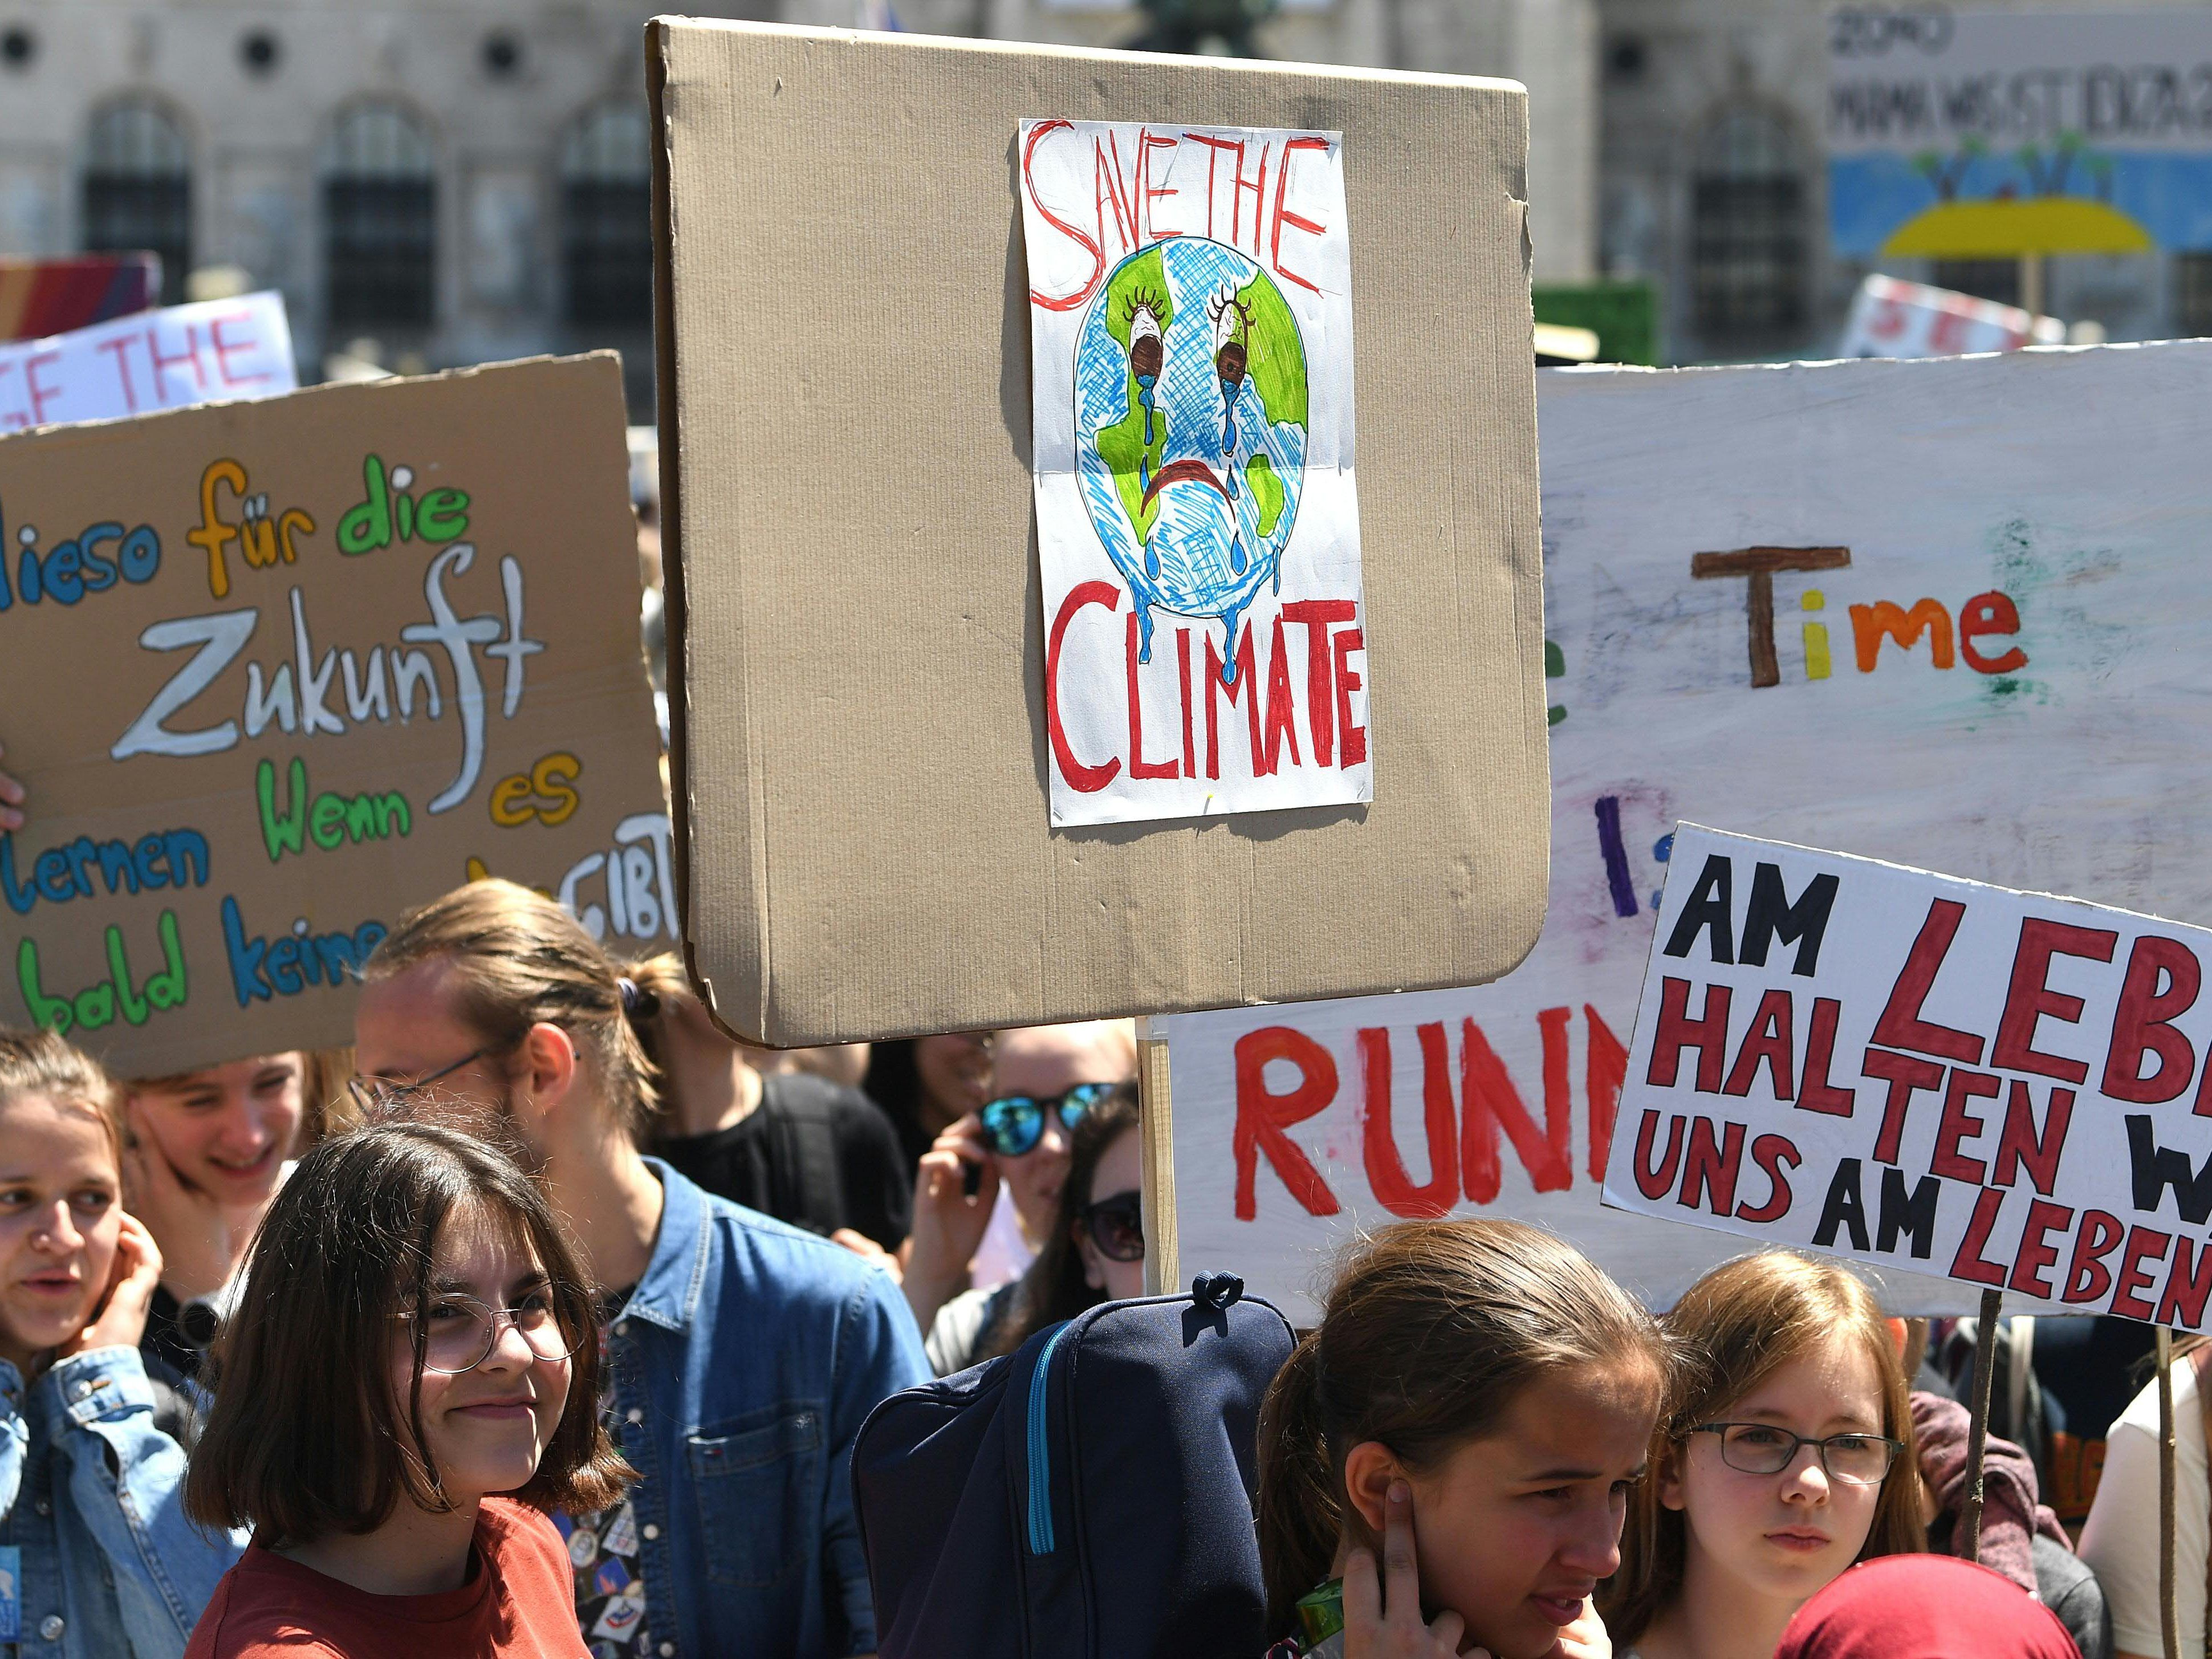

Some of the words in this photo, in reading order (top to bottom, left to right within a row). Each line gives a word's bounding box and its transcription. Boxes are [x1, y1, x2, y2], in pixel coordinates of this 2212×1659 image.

[1023, 119, 1184, 311] SAVE
[1181, 131, 1326, 299] THE
[96, 310, 273, 412] THE
[0, 494, 162, 612] ieso
[186, 457, 316, 600] für
[336, 453, 471, 556] die
[1691, 546, 2028, 689] Time
[109, 542, 547, 815] Zukunft
[1046, 580, 1367, 793] CLIMATE
[256, 756, 412, 863] Wenn
[489, 751, 582, 828] es
[17, 908, 188, 1036] bald
[1663, 855, 1840, 977] AM
[1868, 897, 2212, 1119] LEB
[1633, 1108, 1802, 1223] UNS
[1811, 1157, 1941, 1259] AM
[1948, 1185, 2212, 1330] LEBEN
